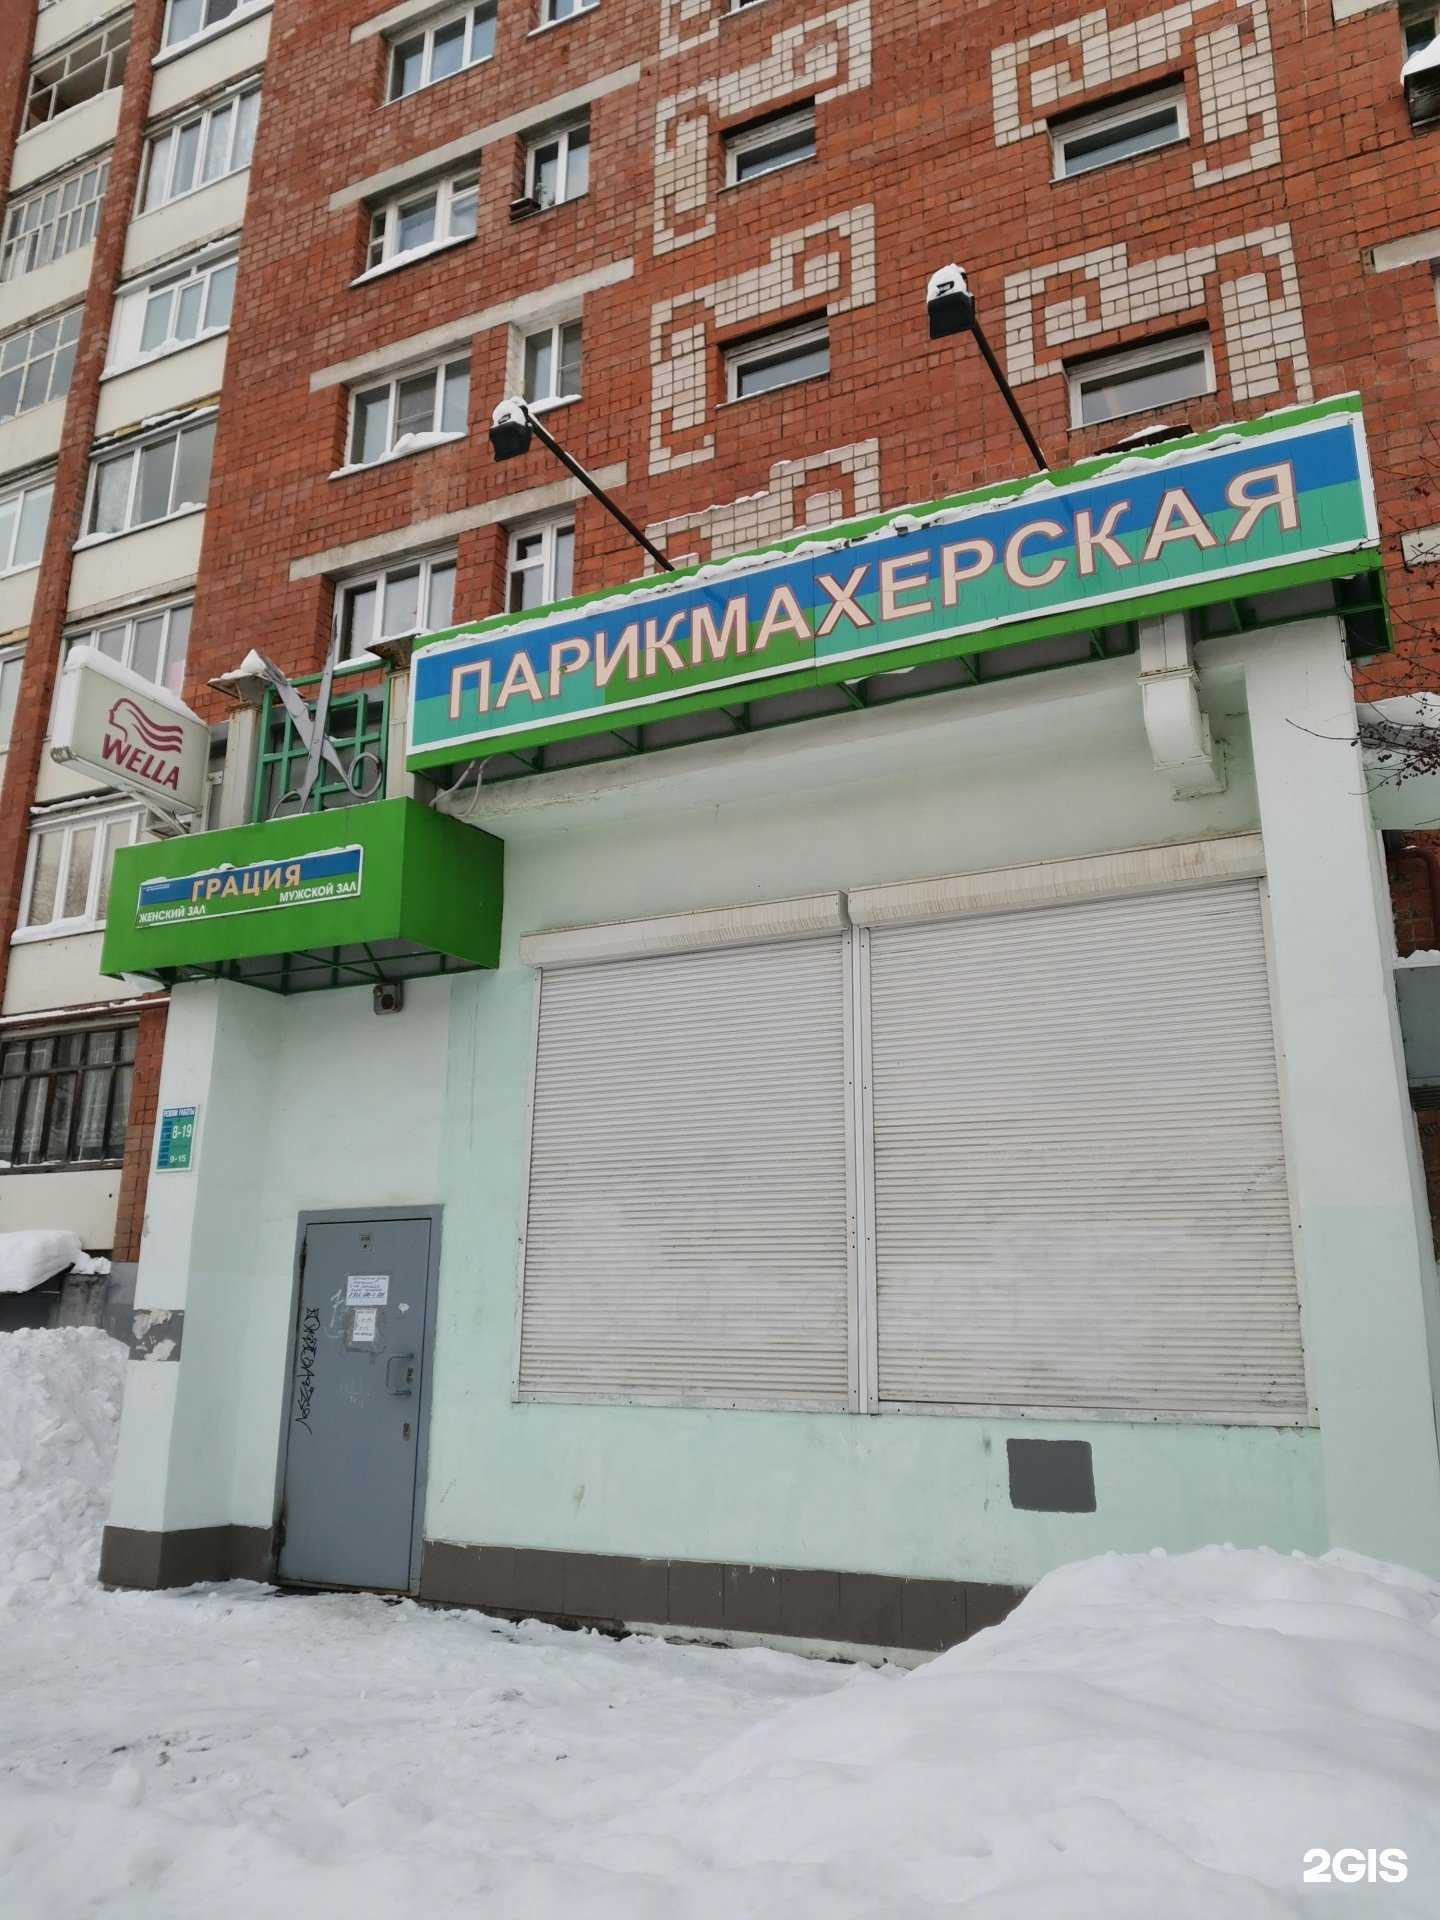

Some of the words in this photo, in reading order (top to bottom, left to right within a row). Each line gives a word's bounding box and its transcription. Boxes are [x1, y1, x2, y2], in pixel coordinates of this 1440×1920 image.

[448, 461, 1302, 720] ПАРИКМАХЕРСКАЯ
[102, 734, 179, 791] WELLA
[191, 863, 301, 902] ГРАЦИЯ
[280, 882, 333, 902] МУЖСКОЙ
[336, 881, 357, 894] ЗАЛ
[139, 905, 185, 922] ЖЕНСКИЙ
[187, 904, 206, 917] ЗАЛ
[172, 1124, 192, 1139] 8-19
